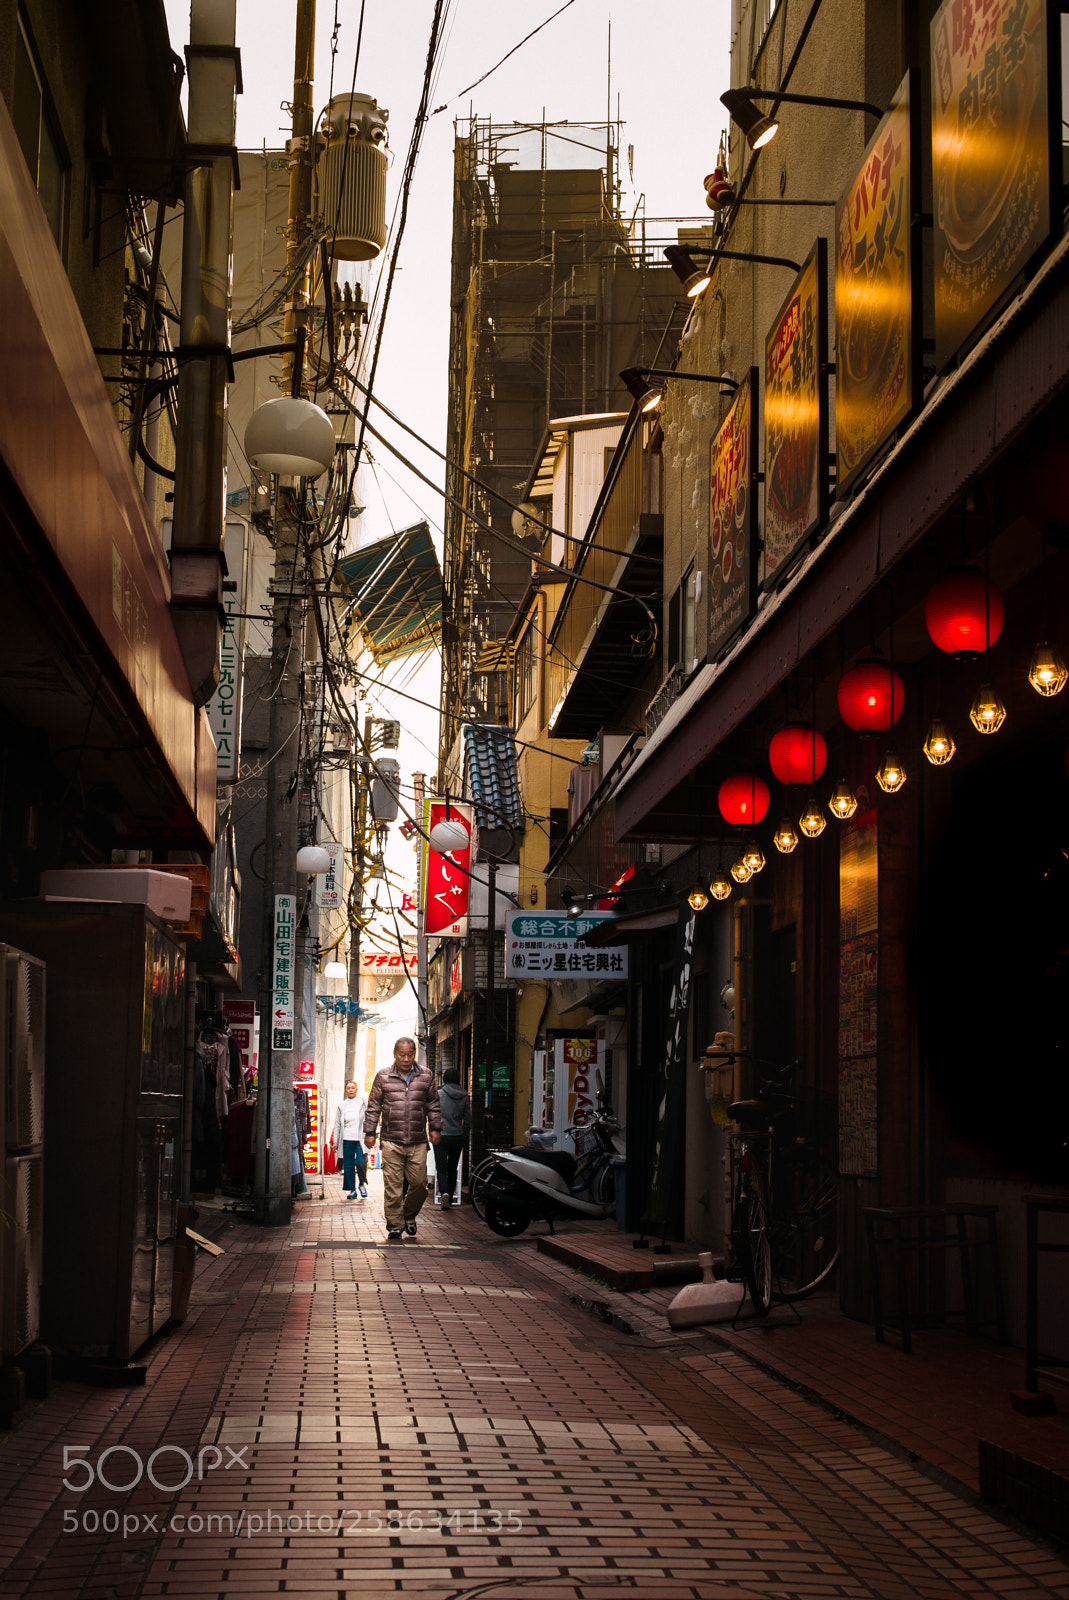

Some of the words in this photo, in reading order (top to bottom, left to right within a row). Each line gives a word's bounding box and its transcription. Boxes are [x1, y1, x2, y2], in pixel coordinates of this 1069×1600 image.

[520, 919, 604, 936] 総合不動
[567, 1047, 592, 1058] 100
